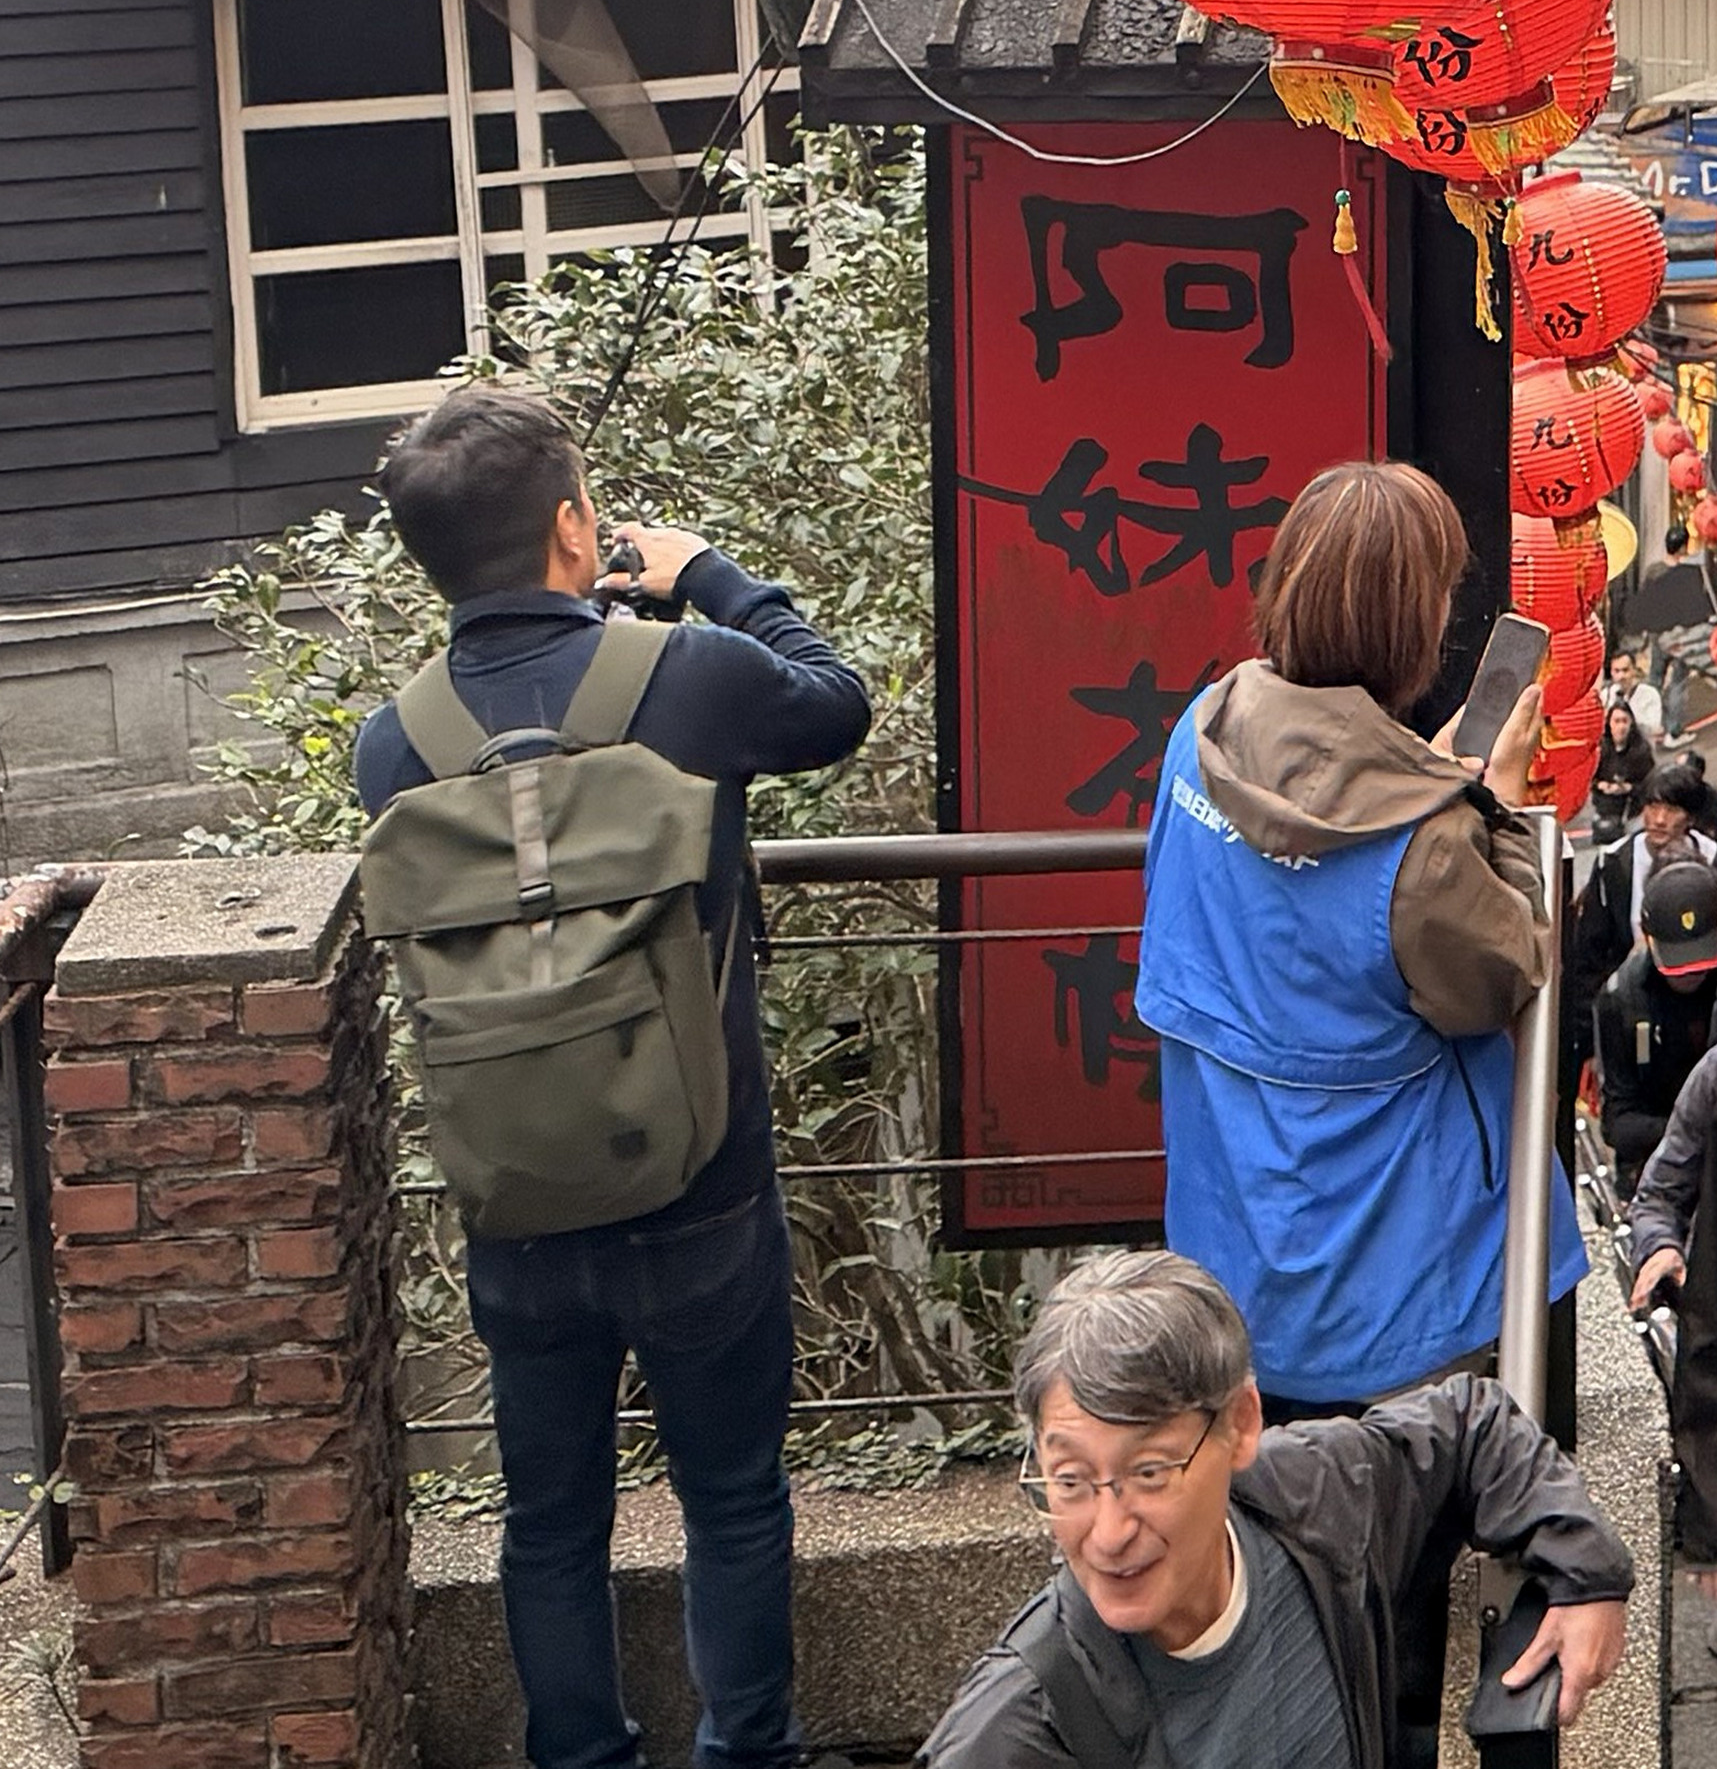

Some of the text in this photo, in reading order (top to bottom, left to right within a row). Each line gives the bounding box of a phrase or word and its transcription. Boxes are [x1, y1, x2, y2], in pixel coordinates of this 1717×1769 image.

[1403, 27, 1483, 87] 份
[1416, 108, 1468, 156] 份
[1527, 229, 1590, 343] 九份
[1530, 415, 1580, 510] 九份
